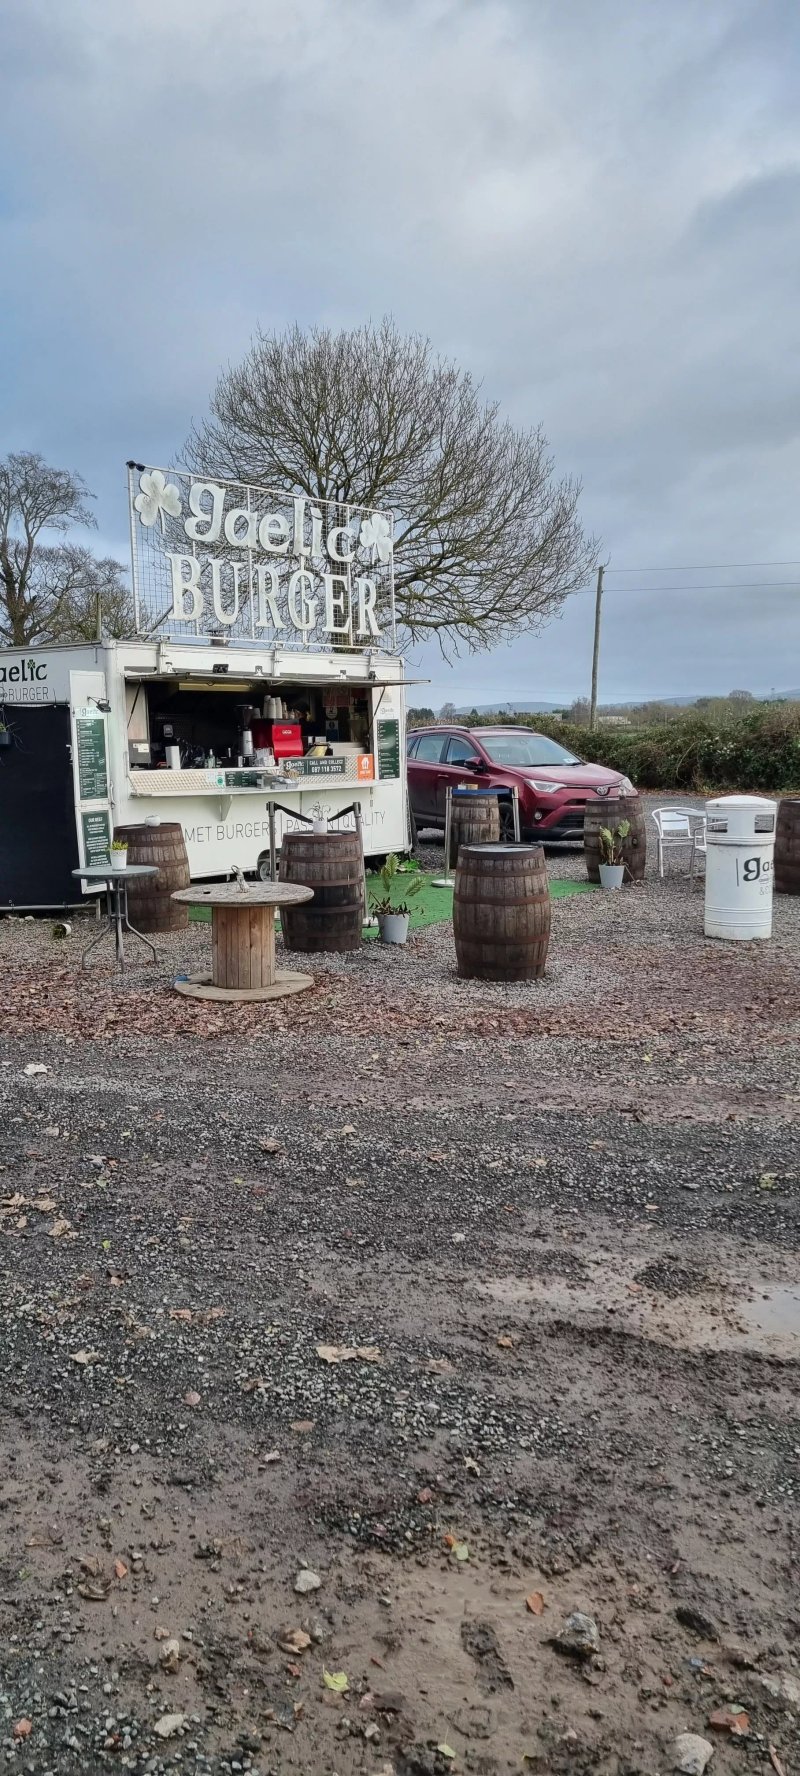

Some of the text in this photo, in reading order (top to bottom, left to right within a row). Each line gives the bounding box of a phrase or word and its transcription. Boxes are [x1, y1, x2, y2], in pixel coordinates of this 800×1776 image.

[184, 482, 356, 563] gaelic
[164, 552, 383, 636] BURGER
[0, 658, 48, 682] aelic
[8, 686, 49, 701] BURGER
[216, 821, 277, 841] BURGER
[286, 817, 334, 833] PASSN
